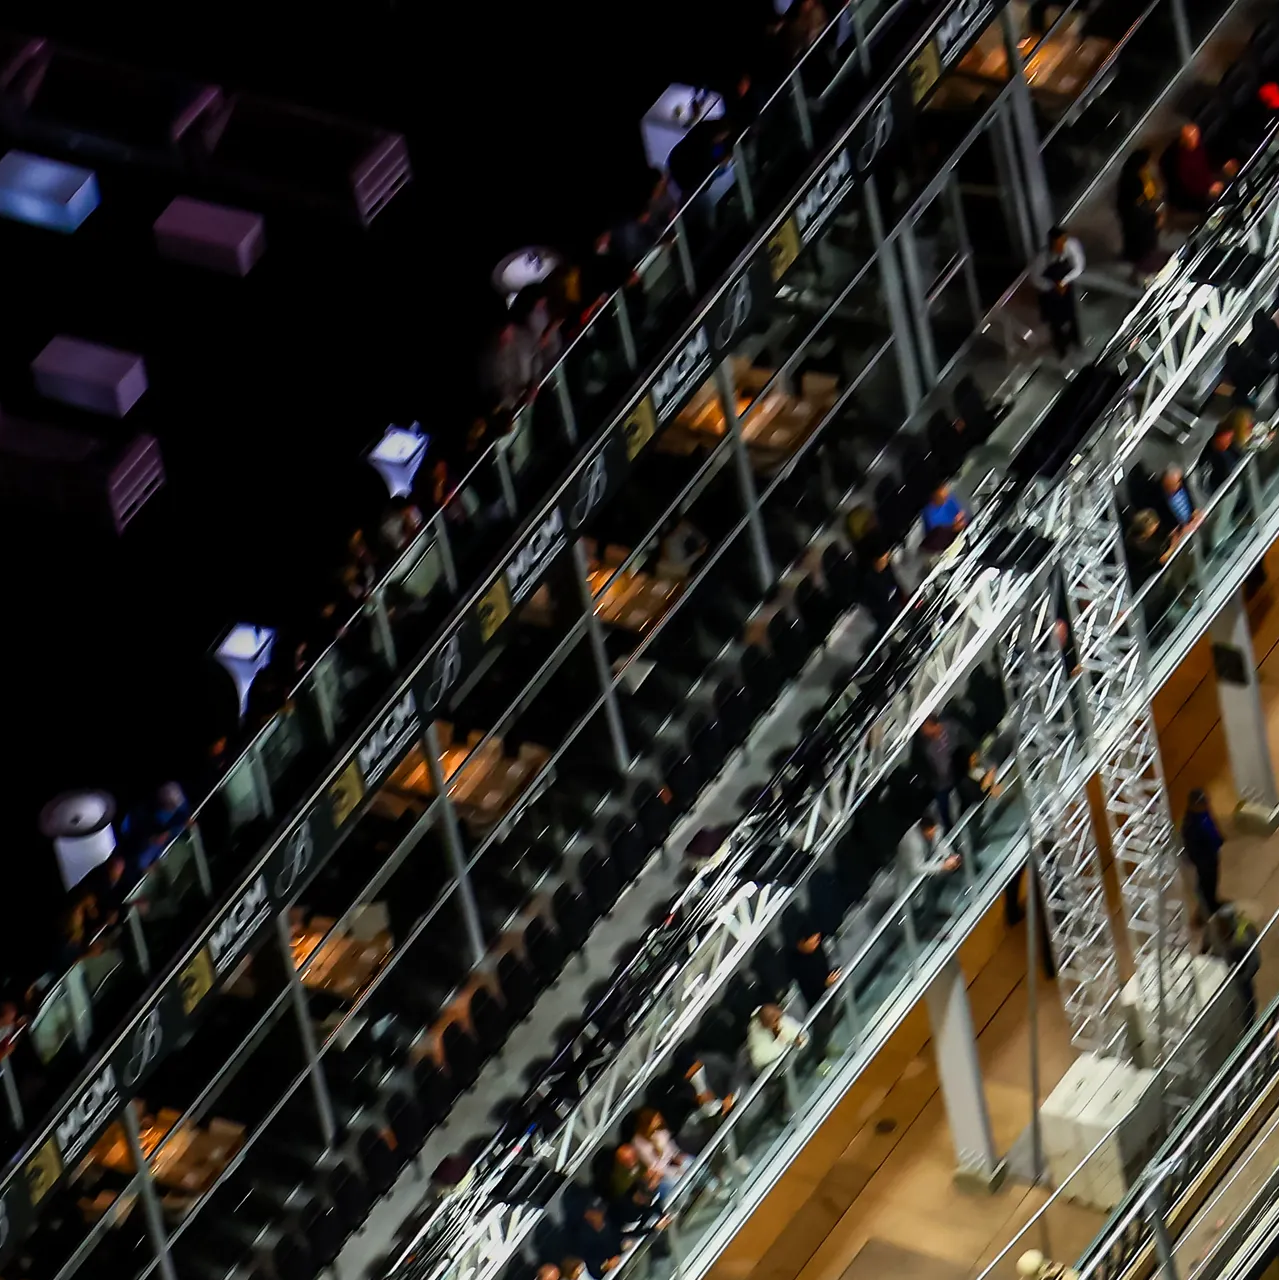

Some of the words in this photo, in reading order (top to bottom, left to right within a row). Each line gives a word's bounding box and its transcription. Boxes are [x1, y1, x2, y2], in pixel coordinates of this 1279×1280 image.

[796, 149, 851, 230] MGM
[652, 326, 709, 408] MGM
[506, 505, 563, 590] MGM
[358, 689, 417, 775] MGM
[208, 874, 268, 961] MGM
[55, 1064, 117, 1146] MGM
